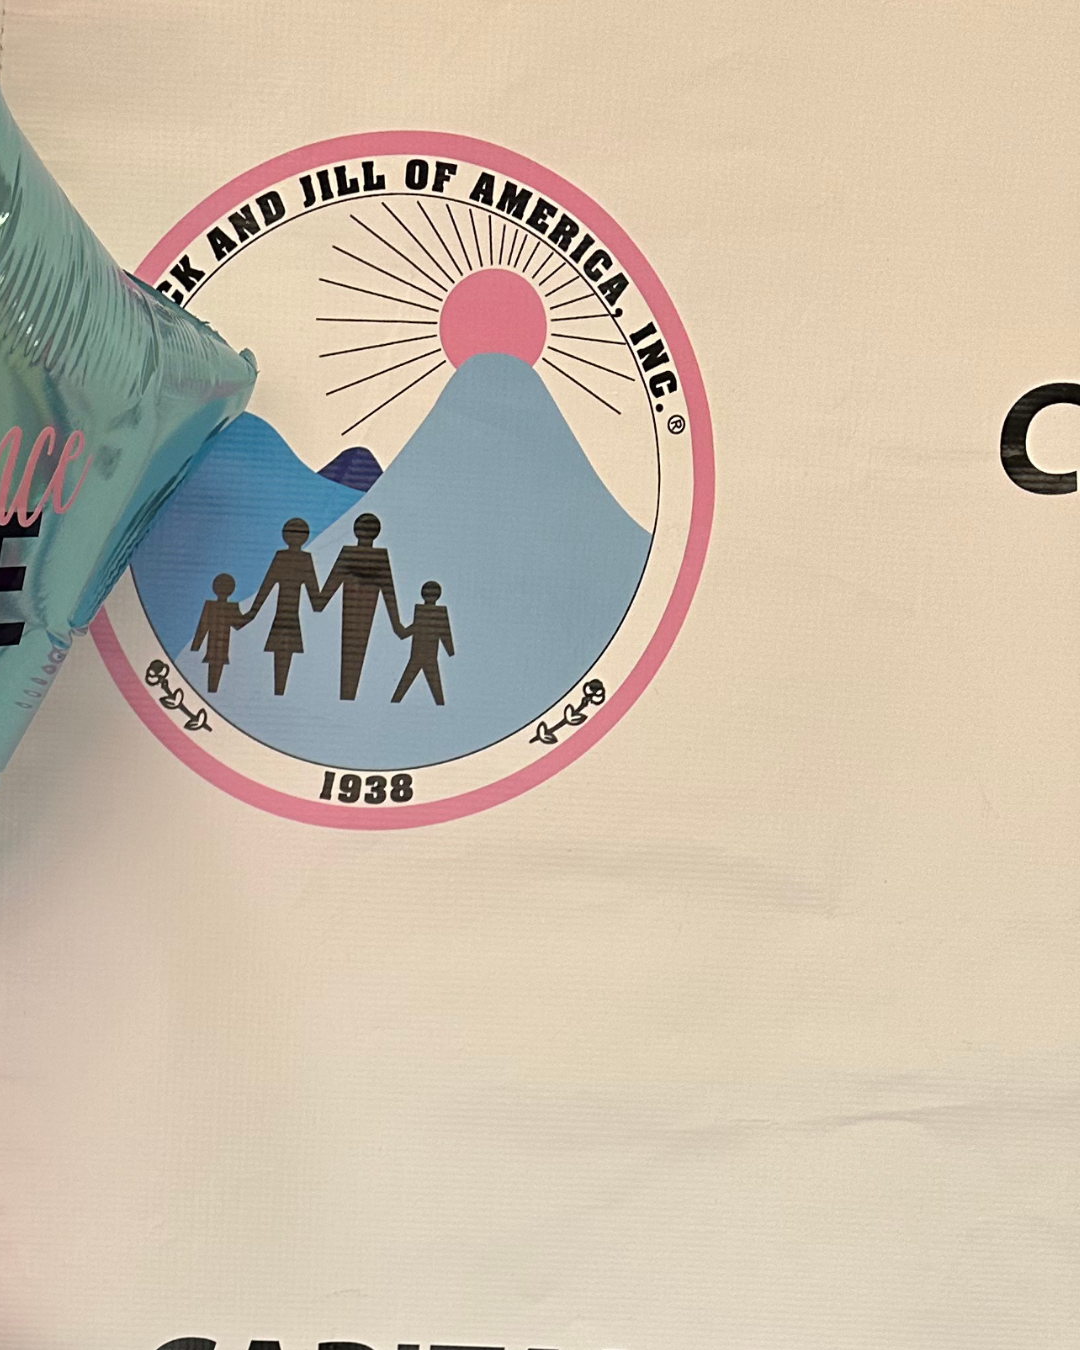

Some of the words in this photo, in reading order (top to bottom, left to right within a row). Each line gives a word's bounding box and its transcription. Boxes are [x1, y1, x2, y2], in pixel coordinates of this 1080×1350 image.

[205, 190, 287, 262] AND
[299, 161, 385, 207] JILL
[404, 158, 457, 193] OF
[469, 172, 630, 318] AMERICA,
[319, 771, 414, 804] 1938
